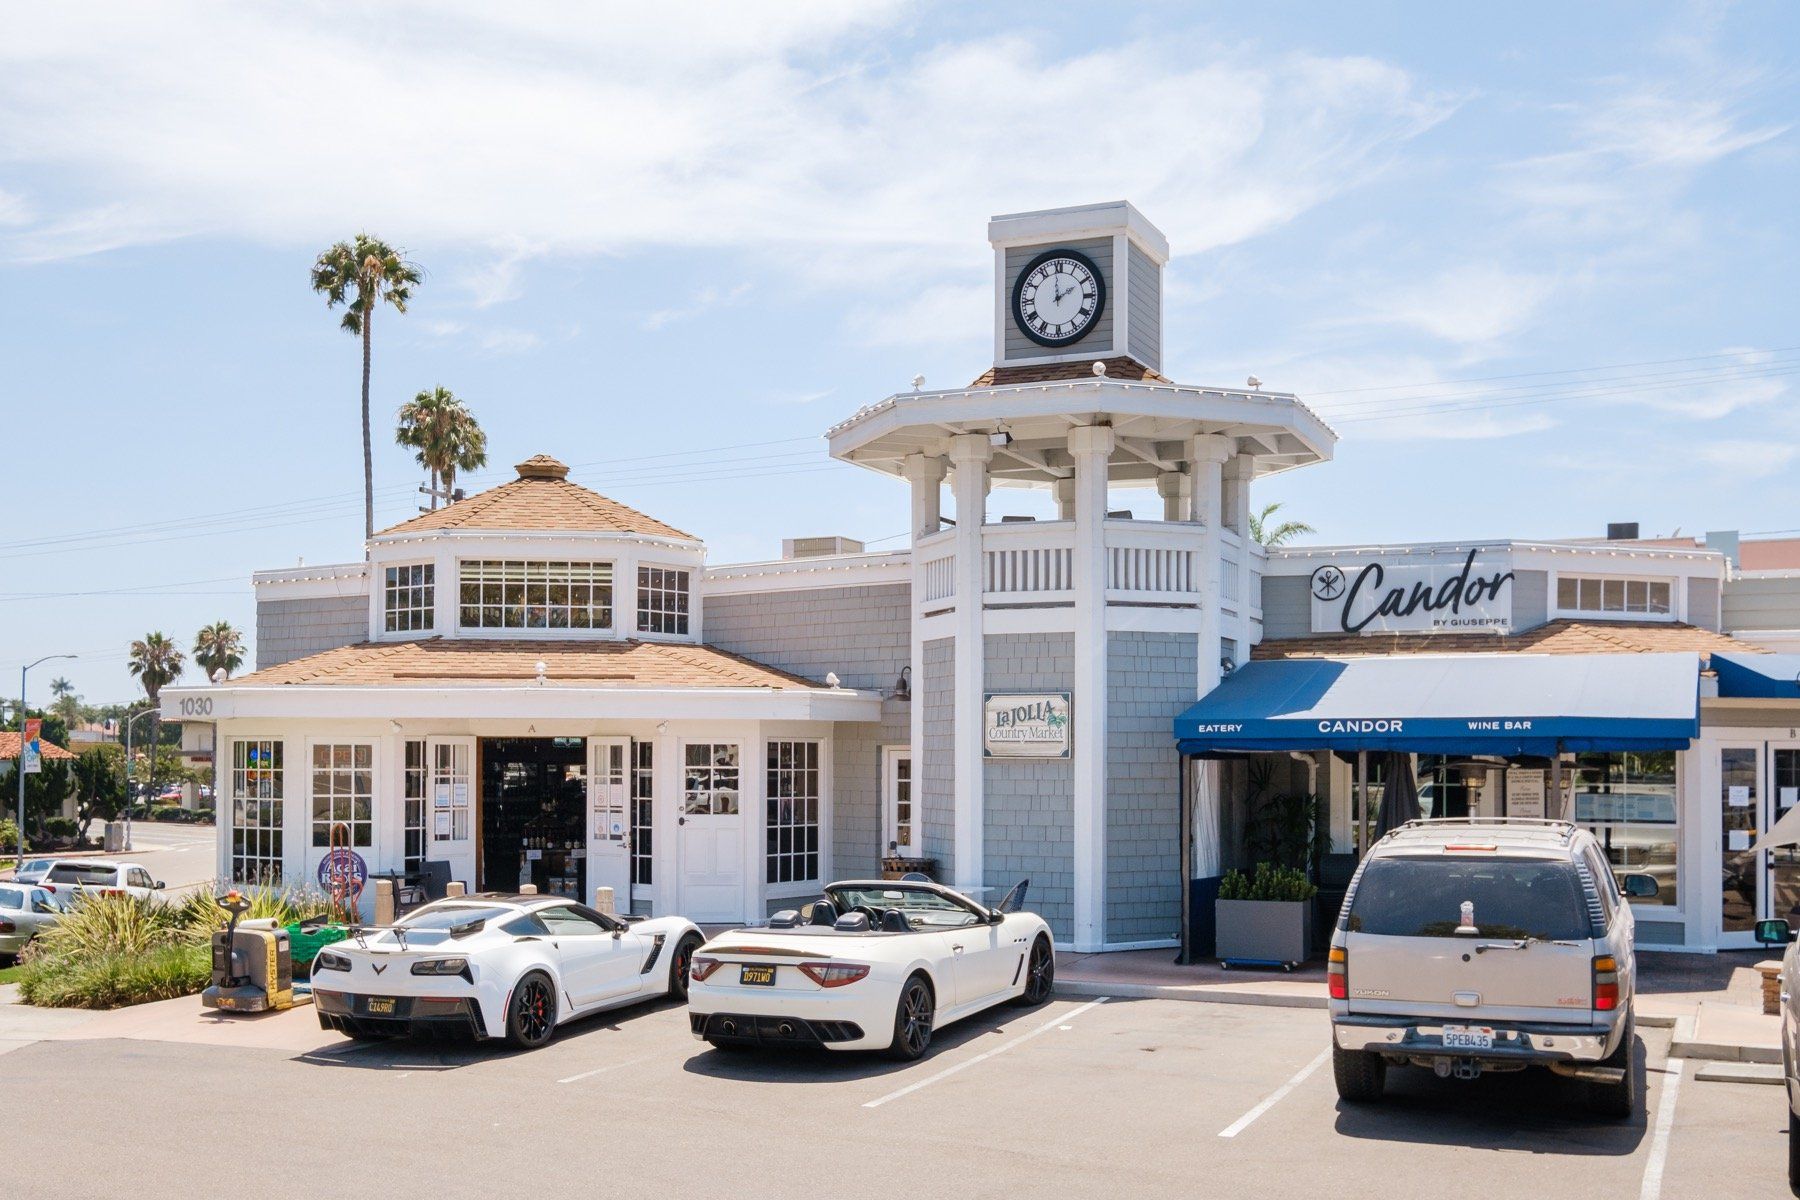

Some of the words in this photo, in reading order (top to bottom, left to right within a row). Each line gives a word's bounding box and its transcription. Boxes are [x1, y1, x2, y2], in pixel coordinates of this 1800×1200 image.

[1341, 548, 1516, 634] Candor
[1433, 618, 1448, 627] BY
[1450, 617, 1509, 627] GIUSEPPE
[179, 697, 213, 716] 1030
[1009, 700, 1056, 729] JOLLA
[528, 724, 536, 733] A
[1198, 724, 1243, 733] EATERY
[1318, 720, 1403, 733] CANDOR
[1467, 721, 1500, 730] WINE
[1504, 721, 1532, 730] BAR
[989, 727, 1028, 743] Country
[1029, 726, 1064, 739] Market
[1790, 729, 1797, 738] B
[1355, 989, 1390, 997] YUKON
[1446, 1033, 1489, 1047] 5PEB435
